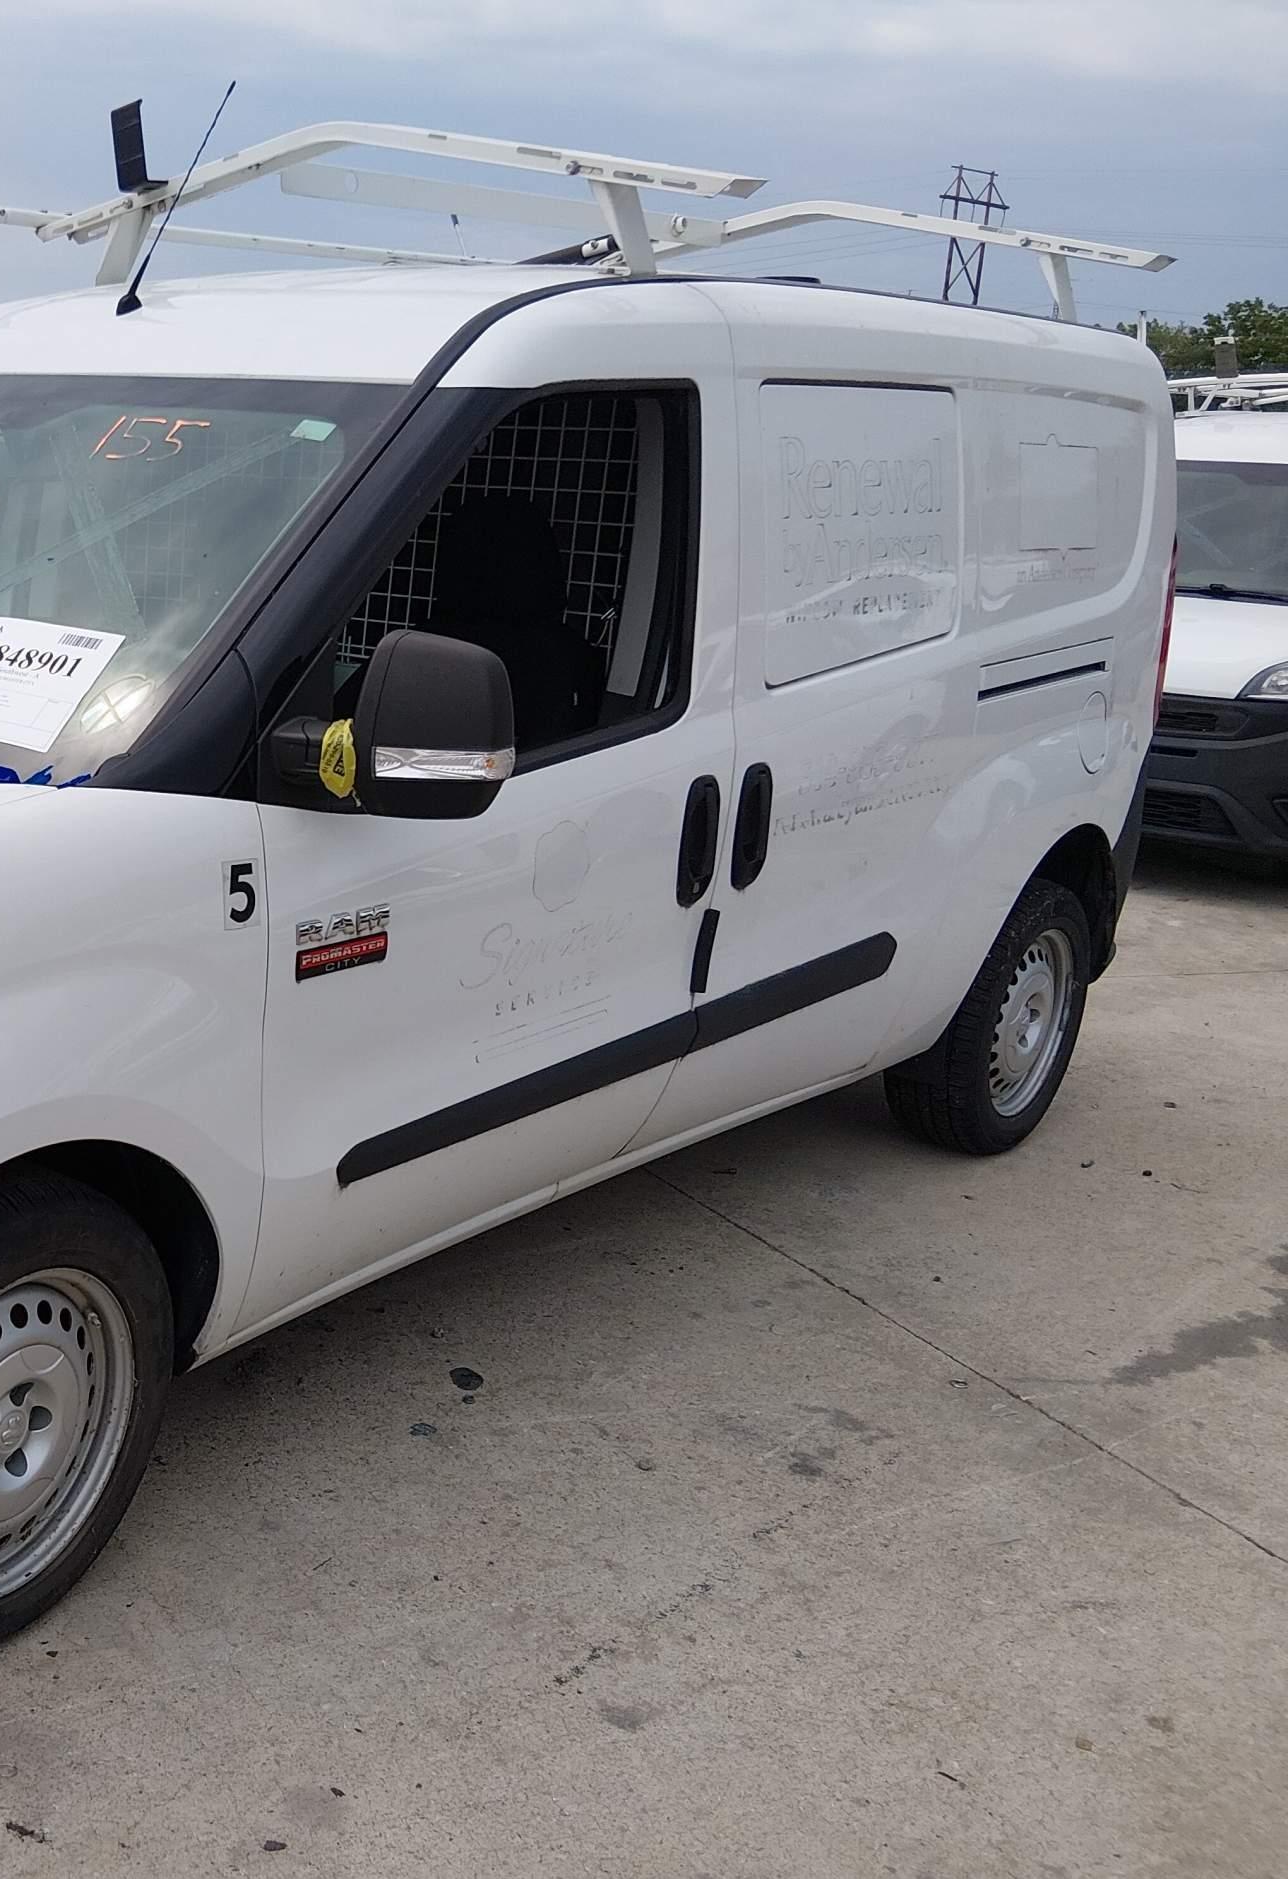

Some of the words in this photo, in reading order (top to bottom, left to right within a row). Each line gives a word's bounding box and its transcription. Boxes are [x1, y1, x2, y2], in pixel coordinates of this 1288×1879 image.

[88, 416, 211, 462] 155
[779, 435, 942, 520] Renewal
[229, 863, 256, 923] 5
[295, 902, 391, 946] RAM
[301, 938, 386, 967] PROMASTER
[325, 957, 361, 972] CITY
